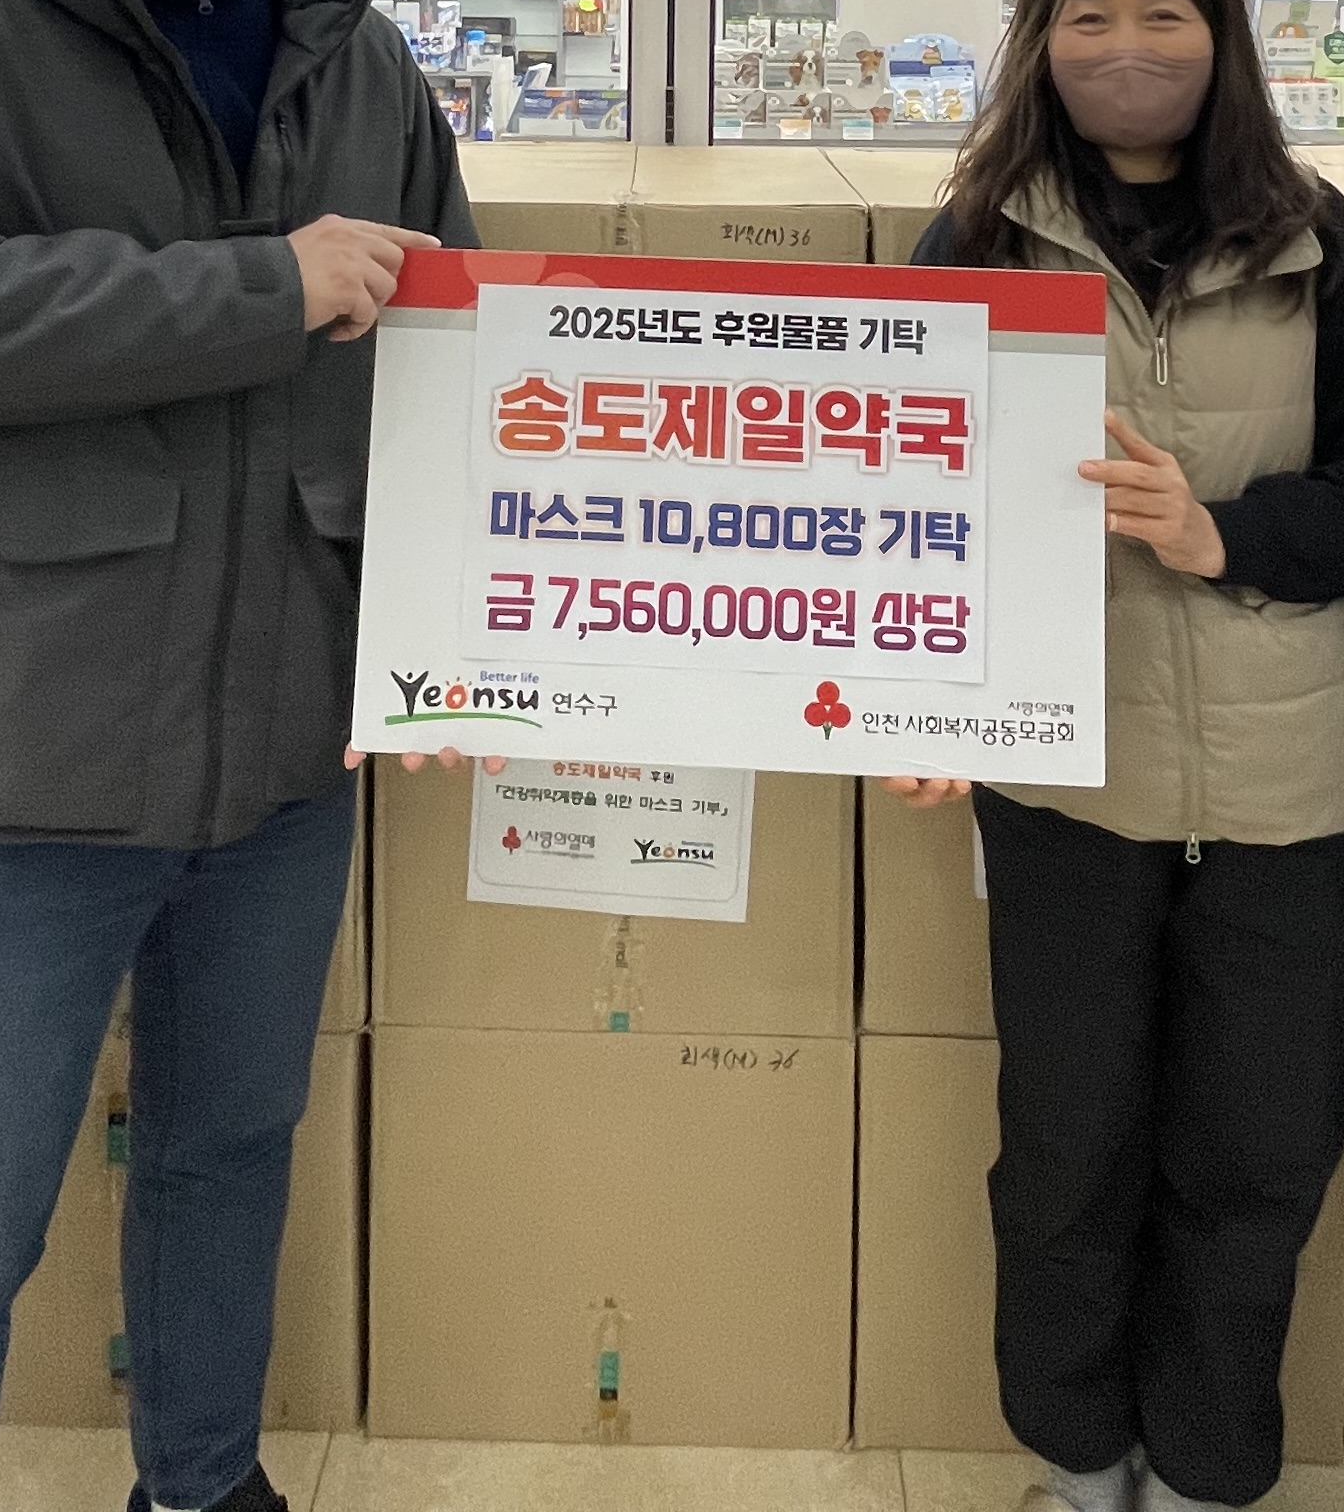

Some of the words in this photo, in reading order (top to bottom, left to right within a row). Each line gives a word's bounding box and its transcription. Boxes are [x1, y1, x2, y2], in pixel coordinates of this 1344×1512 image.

[548, 306, 702, 347] 2025년도
[712, 313, 849, 351] 후원물품
[858, 318, 927, 355] 기탁
[496, 375, 969, 473] 송도제일약국
[489, 490, 625, 544] 마스크
[640, 498, 866, 557] 10,800장
[878, 507, 971, 561] 기탁
[486, 573, 535, 631] 금
[548, 575, 856, 648] 7,560,000원
[872, 591, 971, 654] 상당
[480, 670, 518, 683] Better
[520, 671, 540, 684] life
[390, 670, 540, 717] Yeonsu
[552, 691, 618, 716] 연수구
[861, 711, 899, 735] 인천
[552, 761, 642, 782] 송도제일약국
[604, 792, 633, 809] 위한
[639, 796, 683, 813] 마스크
[633, 838, 715, 861] Yeonsu
